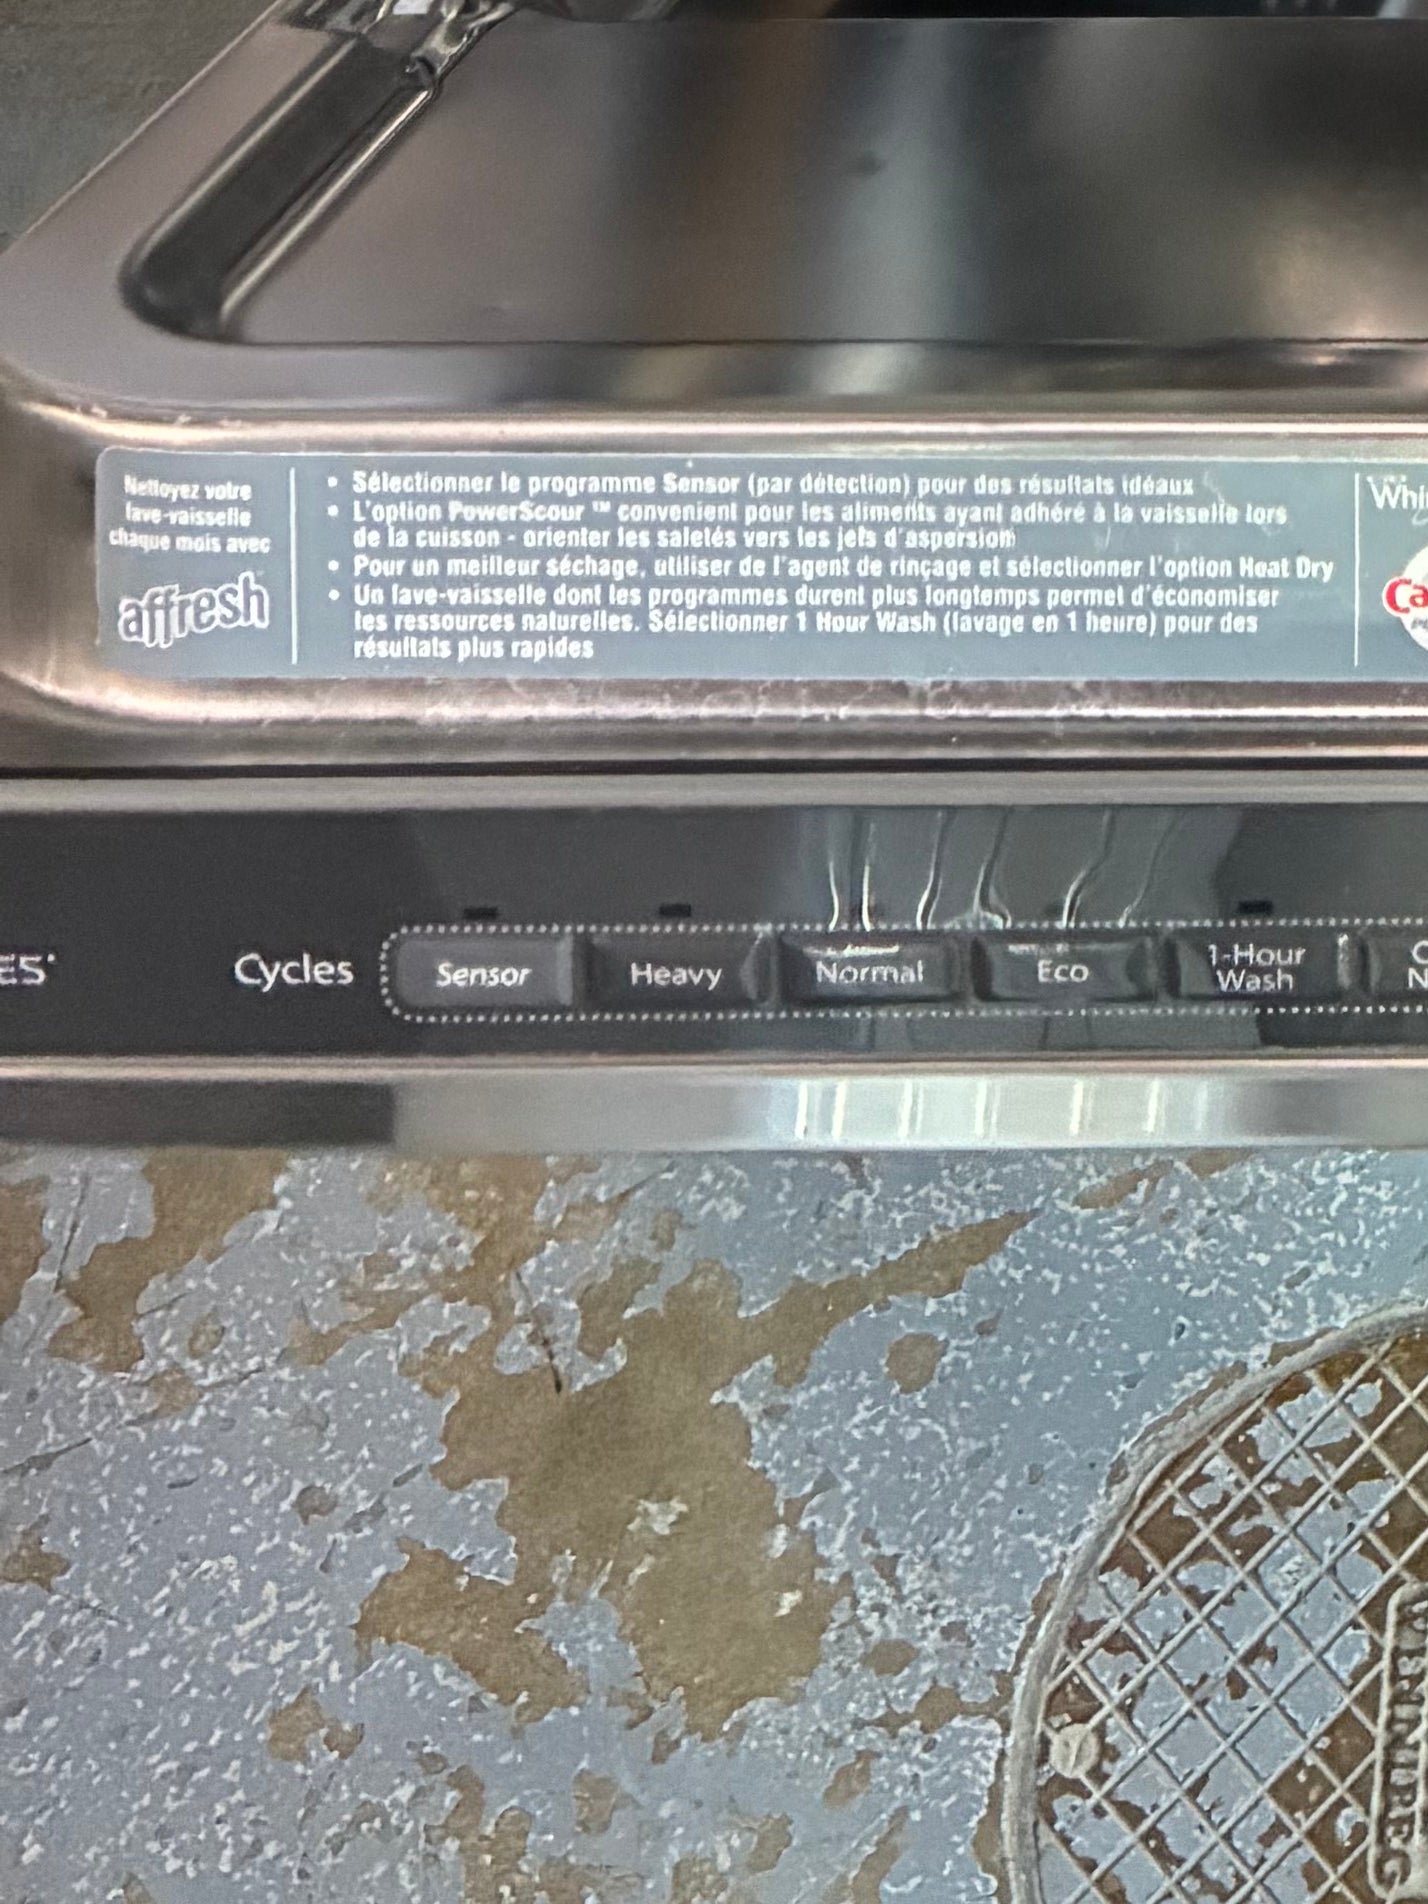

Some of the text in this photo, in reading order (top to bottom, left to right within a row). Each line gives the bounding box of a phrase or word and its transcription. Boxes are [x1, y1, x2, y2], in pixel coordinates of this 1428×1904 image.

[124, 474, 252, 502] Nettoyez votre
[353, 471, 1193, 500] Sélectionner le programme Sensor (par détection) pour des résultats idéaux
[126, 501, 252, 527] lave-vaisselle
[353, 500, 442, 527] L'option
[449, 500, 585, 523] PowerScour
[617, 501, 737, 523] convenient
[745, 506, 794, 528] pour
[802, 501, 834, 524] les
[841, 501, 936, 524] aliments
[944, 501, 1003, 529] ayant
[1011, 501, 1085, 524] adhéré
[1093, 502, 1106, 524] à
[1114, 502, 1133, 524] la
[1141, 502, 1238, 525] vaisselle
[1246, 502, 1287, 525] lors
[109, 527, 271, 553] chaque mois avec
[118, 571, 270, 649] affresh
[354, 636, 594, 664] résultats plus rapides
[1208, 943, 1307, 966] 1-Hour
[235, 952, 354, 993] Cycles
[436, 961, 532, 988] Sensor
[630, 962, 722, 991] Heavy
[815, 961, 924, 985] Normal
[1037, 960, 1090, 983] Eco
[1217, 968, 1295, 992] Wash
